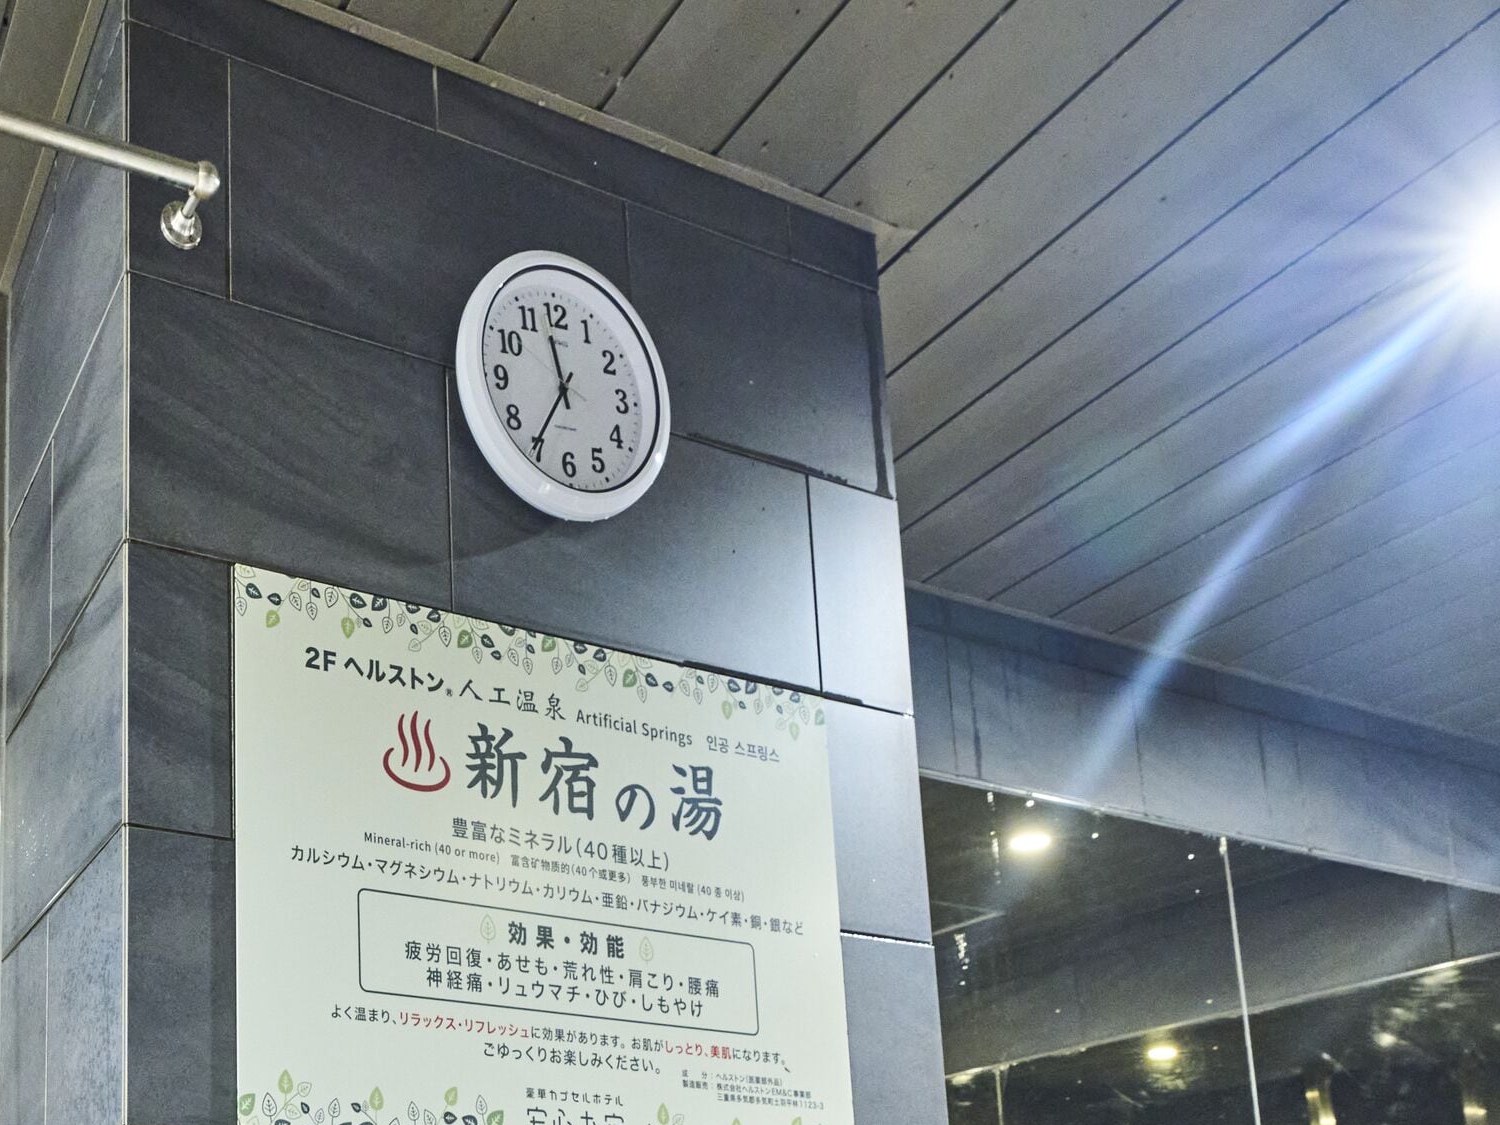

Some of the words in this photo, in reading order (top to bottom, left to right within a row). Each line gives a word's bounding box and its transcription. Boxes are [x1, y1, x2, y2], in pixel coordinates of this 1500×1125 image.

[518, 305, 538, 332] 11
[543, 302, 569, 330] 12
[498, 329, 523, 357] 10
[580, 319, 591, 344] 1
[602, 350, 617, 376] 2
[494, 364, 509, 390] 9
[615, 389, 629, 414] 3
[506, 404, 522, 430] 8
[531, 436, 544, 463] 7
[609, 424, 624, 449] 4
[562, 452, 577, 478] 6
[591, 447, 605, 474] 5
[576, 709, 637, 735] Artificial
[641, 722, 693, 748] Springs
[706, 735, 729, 754] 인공
[734, 741, 781, 763] 스프링스
[465, 721, 723, 841] 新宿の湯
[363, 831, 432, 853] Mineral-rich
[434, 842, 451, 856] (40
[454, 846, 466, 857] or
[468, 848, 500, 865] more)
[641, 875, 667, 890] 풍부한
[669, 878, 695, 894] 미네랄
[697, 881, 712, 897] (40
[507, 920, 625, 960] 効果・効能
[426, 967, 704, 1018] 神経痛・リュウマチ・ひび・しもやけ
[483, 1042, 662, 1075] ごゆっくりお楽しみください。
